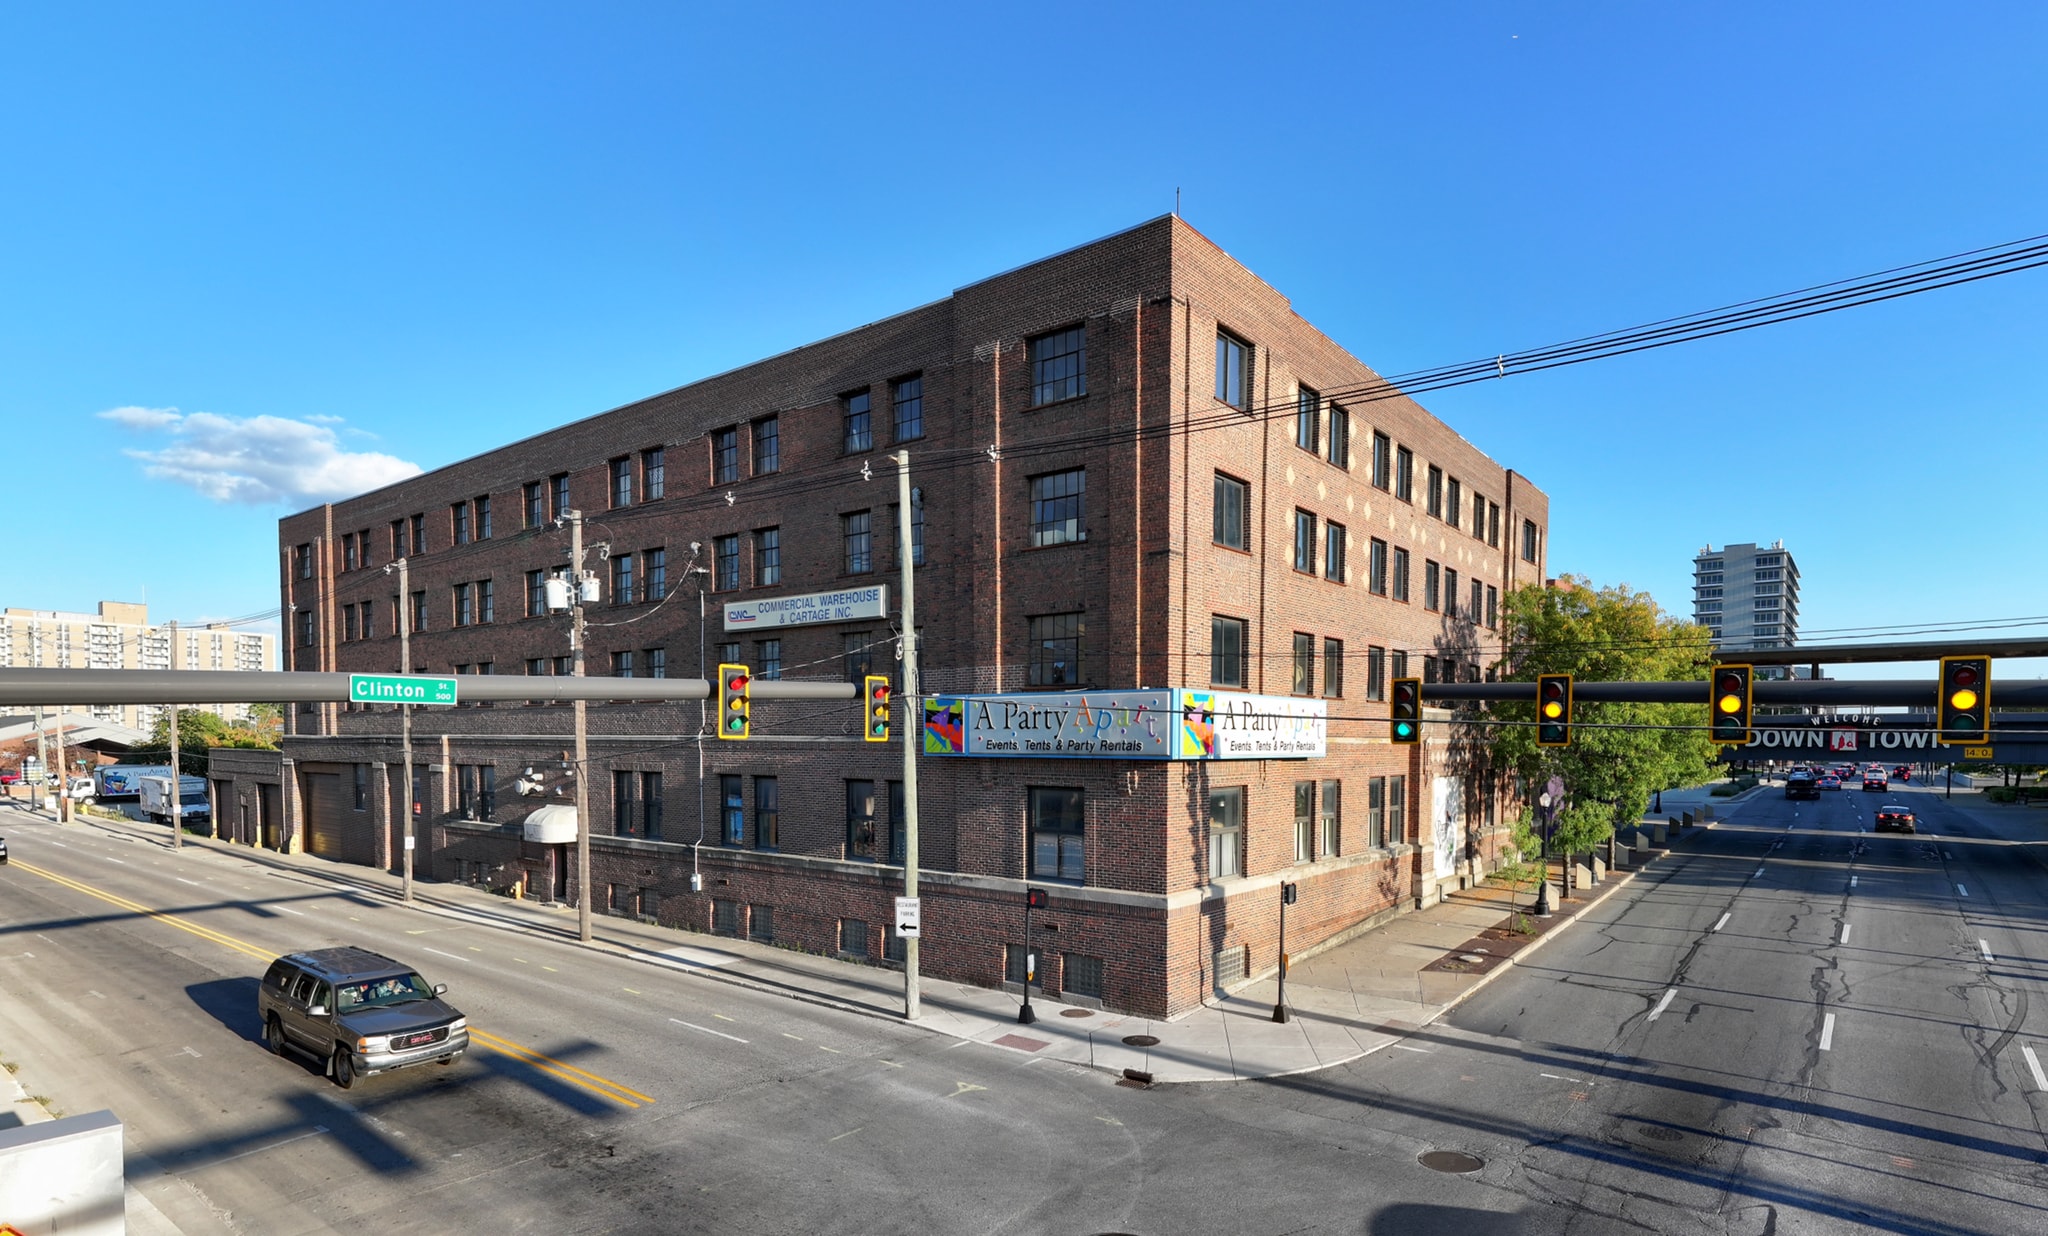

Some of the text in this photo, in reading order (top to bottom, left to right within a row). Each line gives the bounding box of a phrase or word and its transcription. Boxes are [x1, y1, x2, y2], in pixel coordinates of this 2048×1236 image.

[758, 589, 879, 613] COMMERCIAL WAREHOUSE
[779, 606, 854, 624] & CARTAGE INC.
[356, 680, 425, 697] Clinton
[974, 696, 1158, 739] A Party Apart
[1222, 700, 1236, 730] A
[1242, 701, 1281, 740] Party
[1810, 714, 1881, 726] WELCOME
[1025, 739, 1051, 751] Tents
[1056, 738, 1063, 750] &
[1067, 738, 1095, 753] Party
[1100, 737, 1142, 752] Rentals
[1256, 740, 1272, 752] Tents
[1279, 740, 1295, 753] Party
[1296, 740, 1316, 752] Rentals
